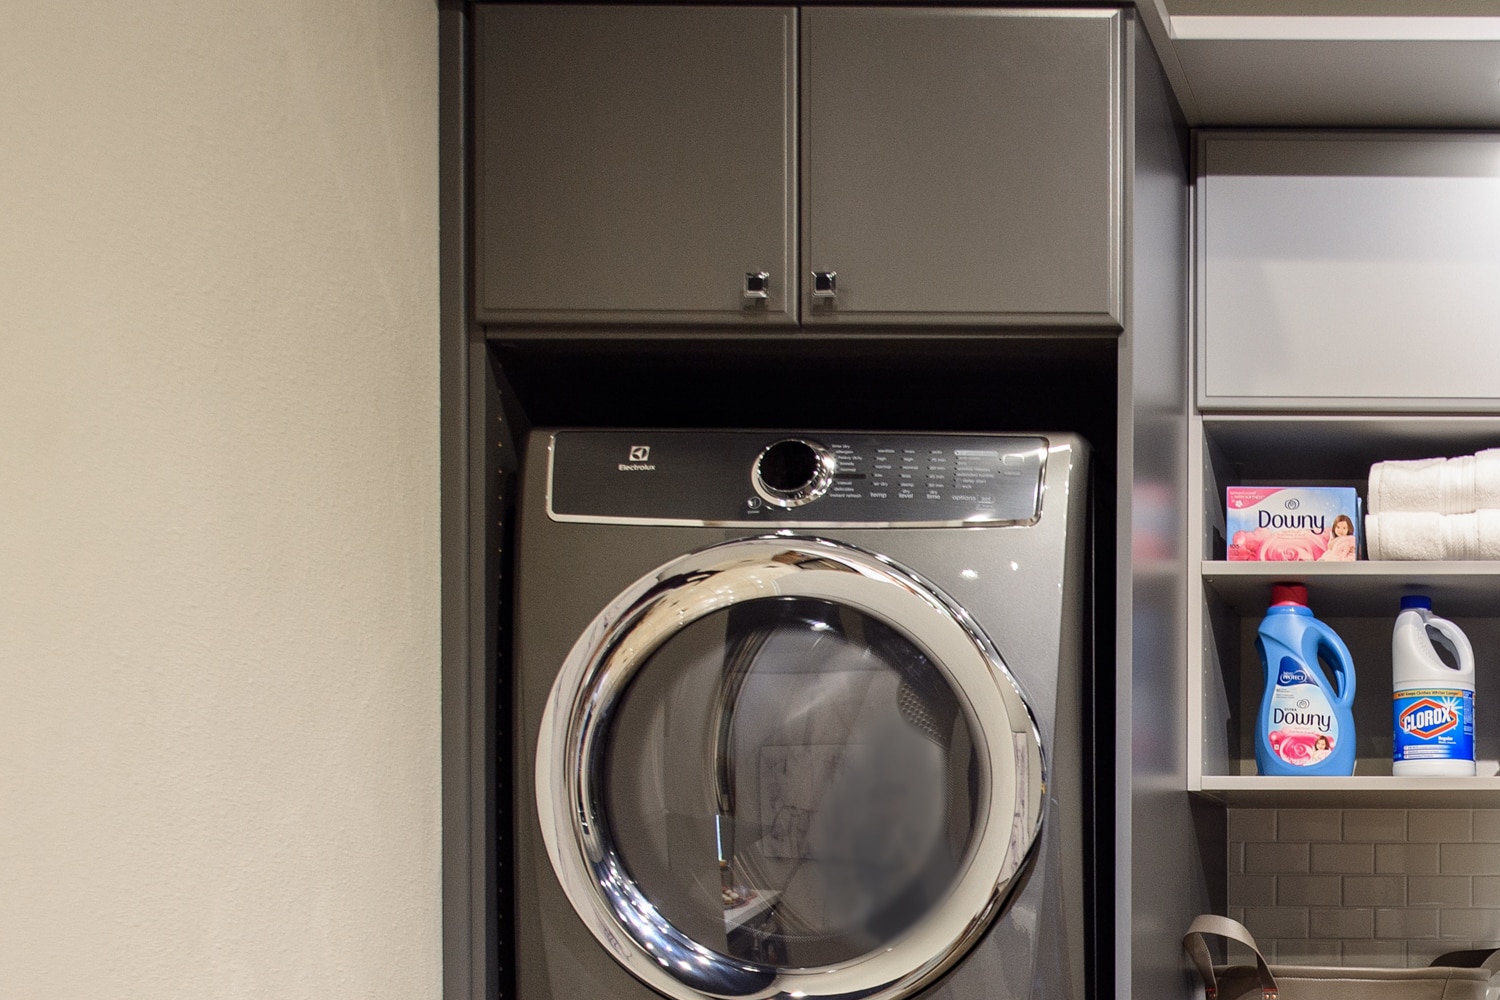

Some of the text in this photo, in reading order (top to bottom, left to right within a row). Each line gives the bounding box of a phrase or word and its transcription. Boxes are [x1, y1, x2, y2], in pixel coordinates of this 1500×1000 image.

[1258, 510, 1324, 535] Downy
[1274, 708, 1331, 732] Downy
[1404, 707, 1451, 732] CLOROX
